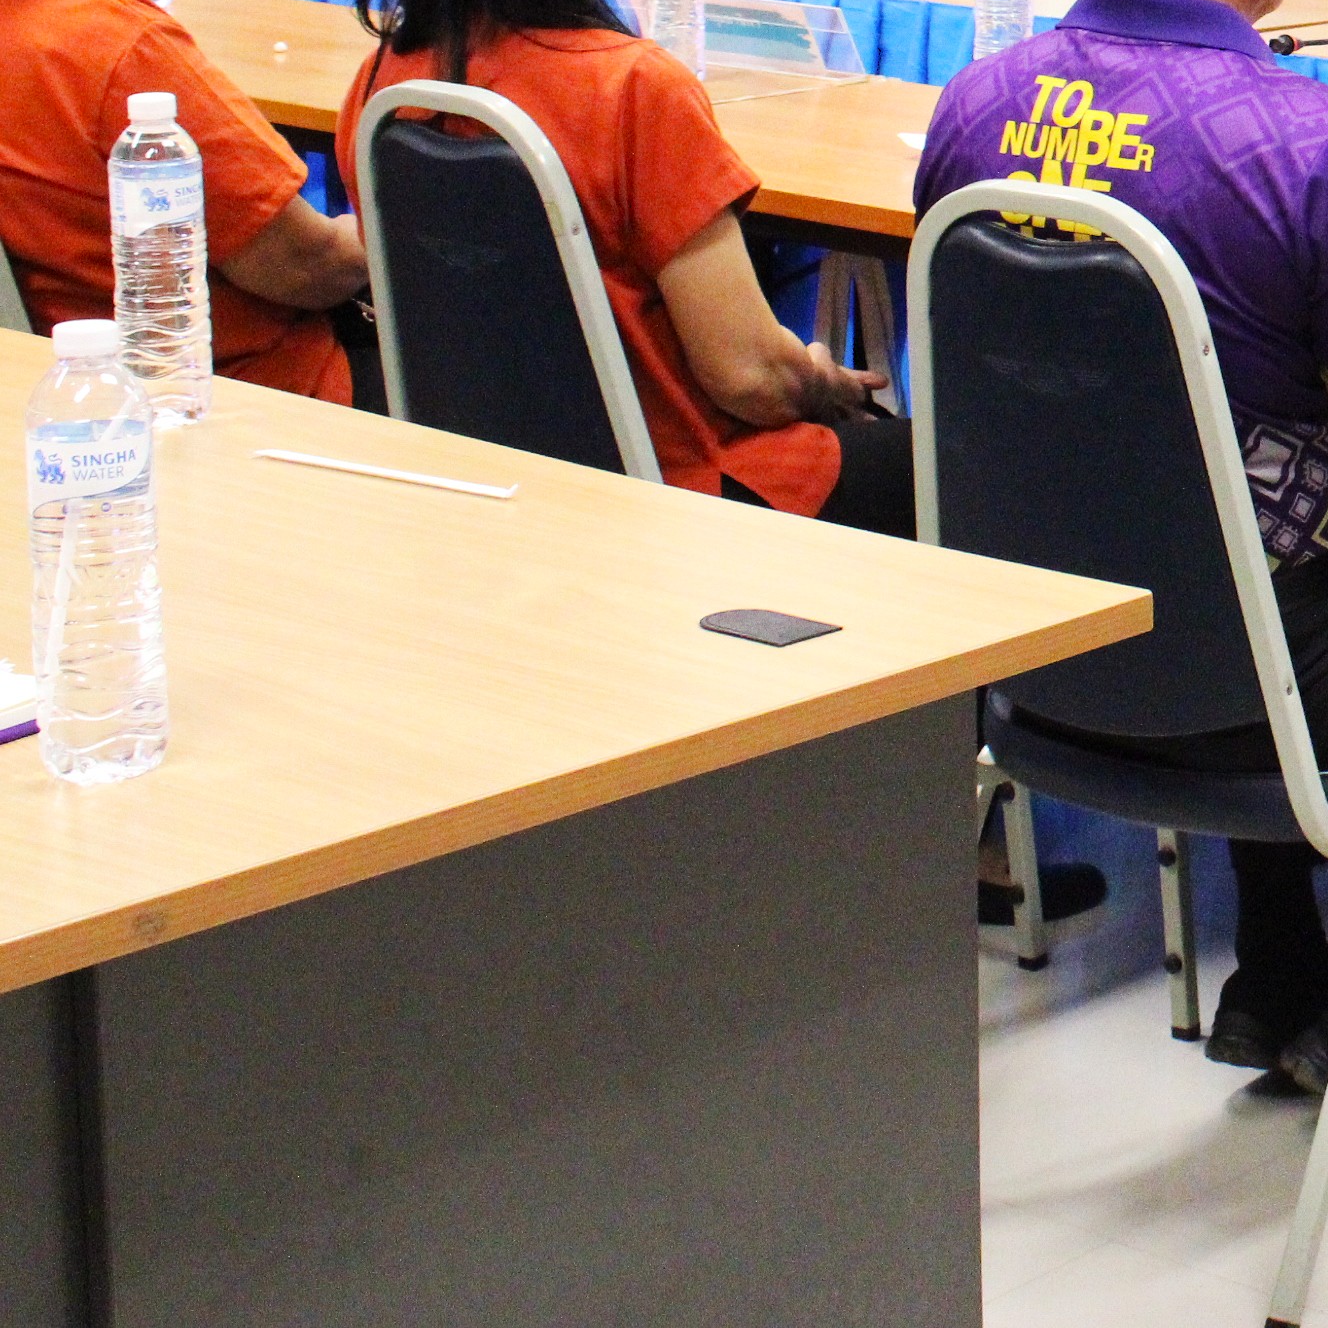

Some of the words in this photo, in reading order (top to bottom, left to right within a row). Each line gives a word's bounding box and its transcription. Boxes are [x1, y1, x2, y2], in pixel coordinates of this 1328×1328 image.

[1030, 75, 1094, 128] TO
[71, 448, 137, 468] SINGHA
[72, 465, 125, 481] WATER
